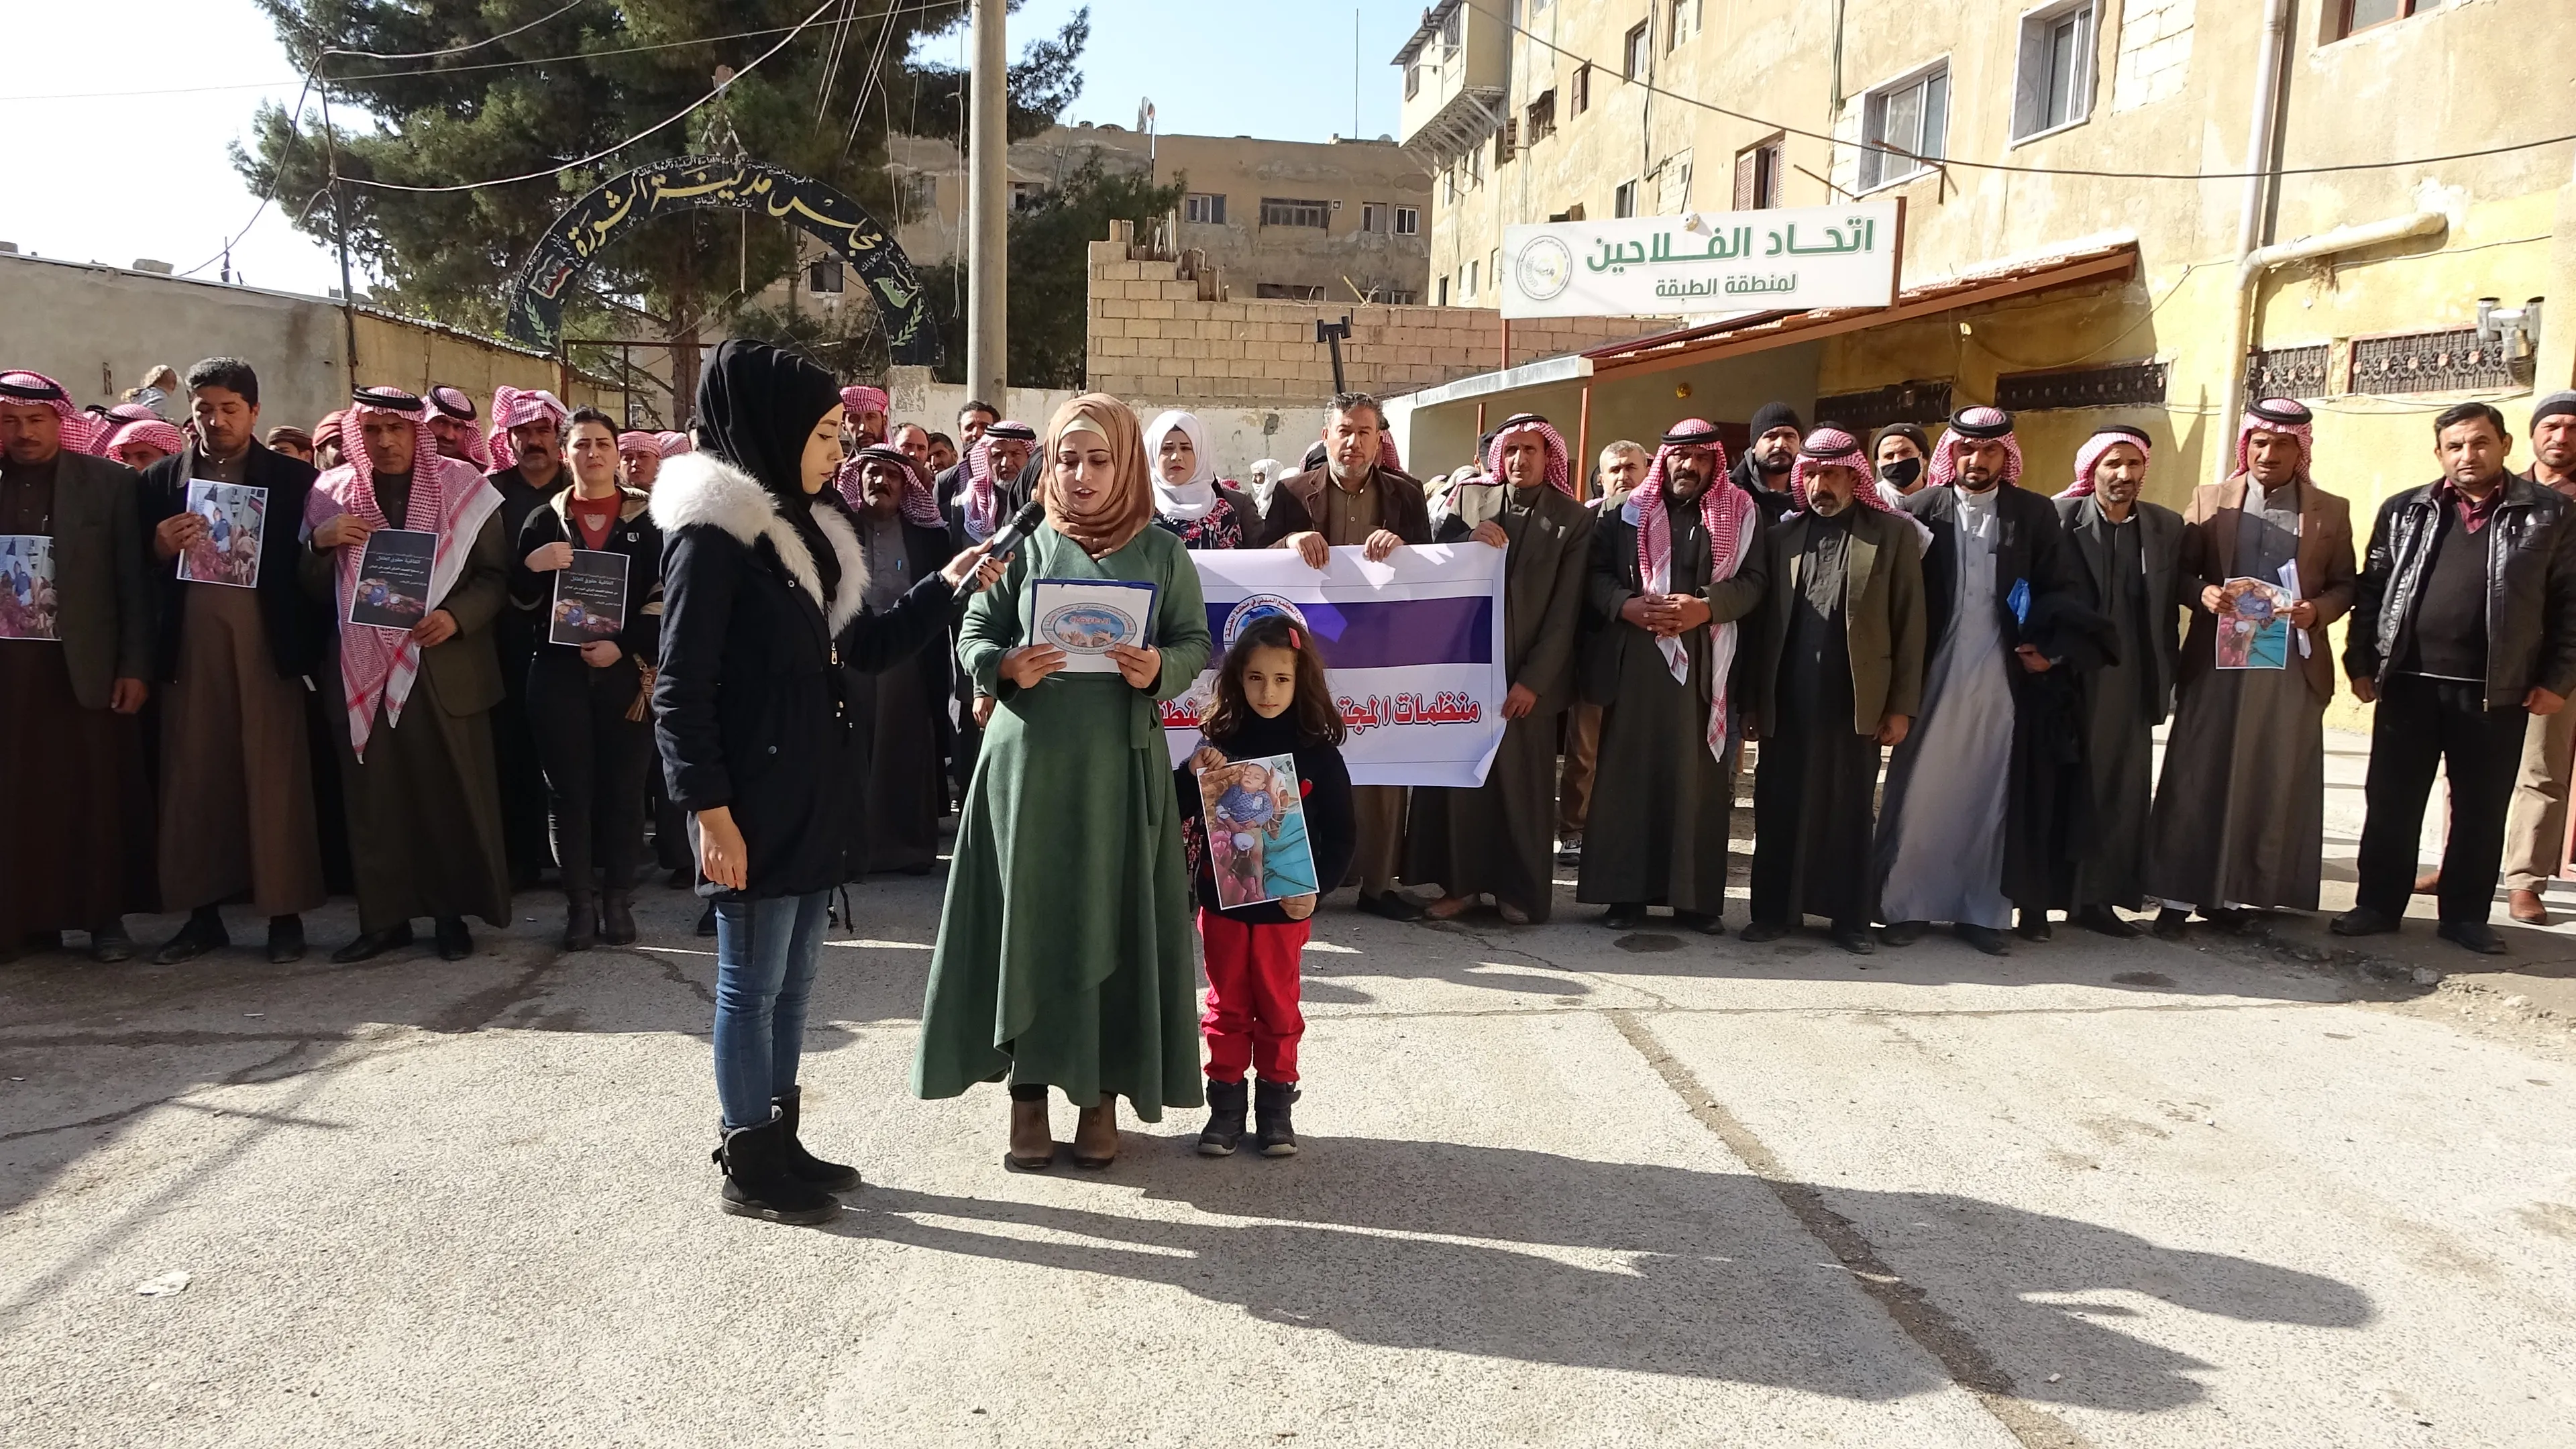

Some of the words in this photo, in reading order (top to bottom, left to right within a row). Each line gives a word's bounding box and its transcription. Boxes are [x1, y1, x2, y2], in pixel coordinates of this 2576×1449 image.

[649, 164, 772, 213] مدينة
[568, 174, 648, 258] الثورة
[768, 190, 883, 257] مجلس
[1587, 226, 1752, 274] الفلاحين
[1765, 216, 1874, 258] اتحاد
[1655, 277, 1718, 302] الطبقة
[1725, 273, 1797, 295] لمنطقة
[1236, 602, 1250, 615] منطقة
[1250, 598, 1256, 608] في
[1257, 597, 1278, 606] المدني
[1278, 600, 1297, 616] المجتمع
[1225, 614, 1236, 638] الطبقة
[1337, 694, 1391, 735] المجت
[1393, 691, 1481, 725] منظمات
